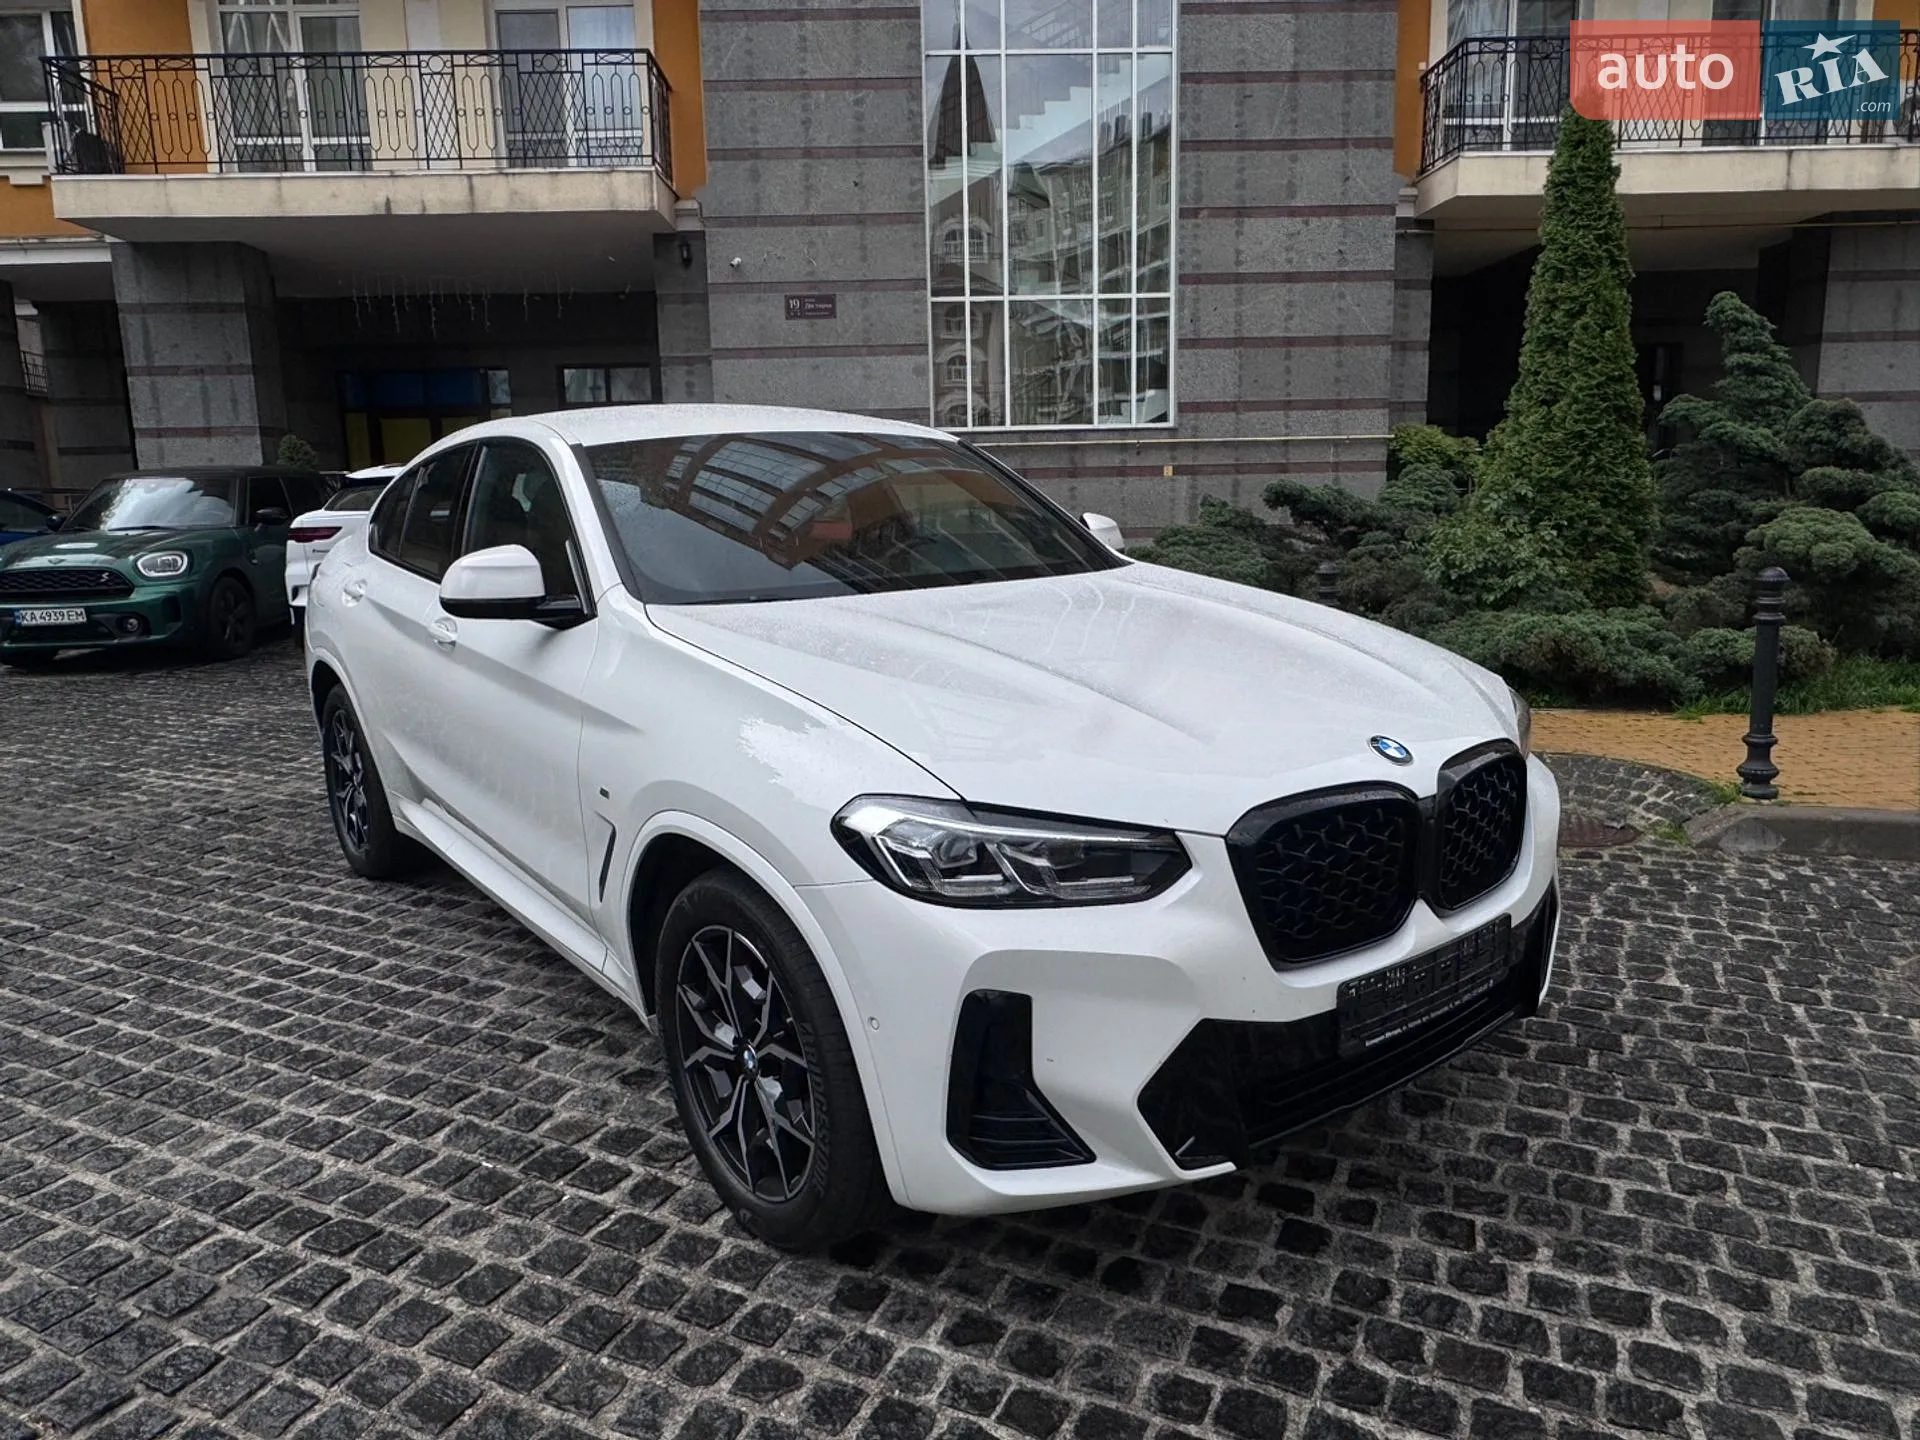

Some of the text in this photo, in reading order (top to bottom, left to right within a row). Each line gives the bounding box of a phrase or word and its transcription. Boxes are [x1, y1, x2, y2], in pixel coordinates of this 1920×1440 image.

[789, 298, 800, 309] 19
[21, 609, 85, 623] KA 4939 EM
